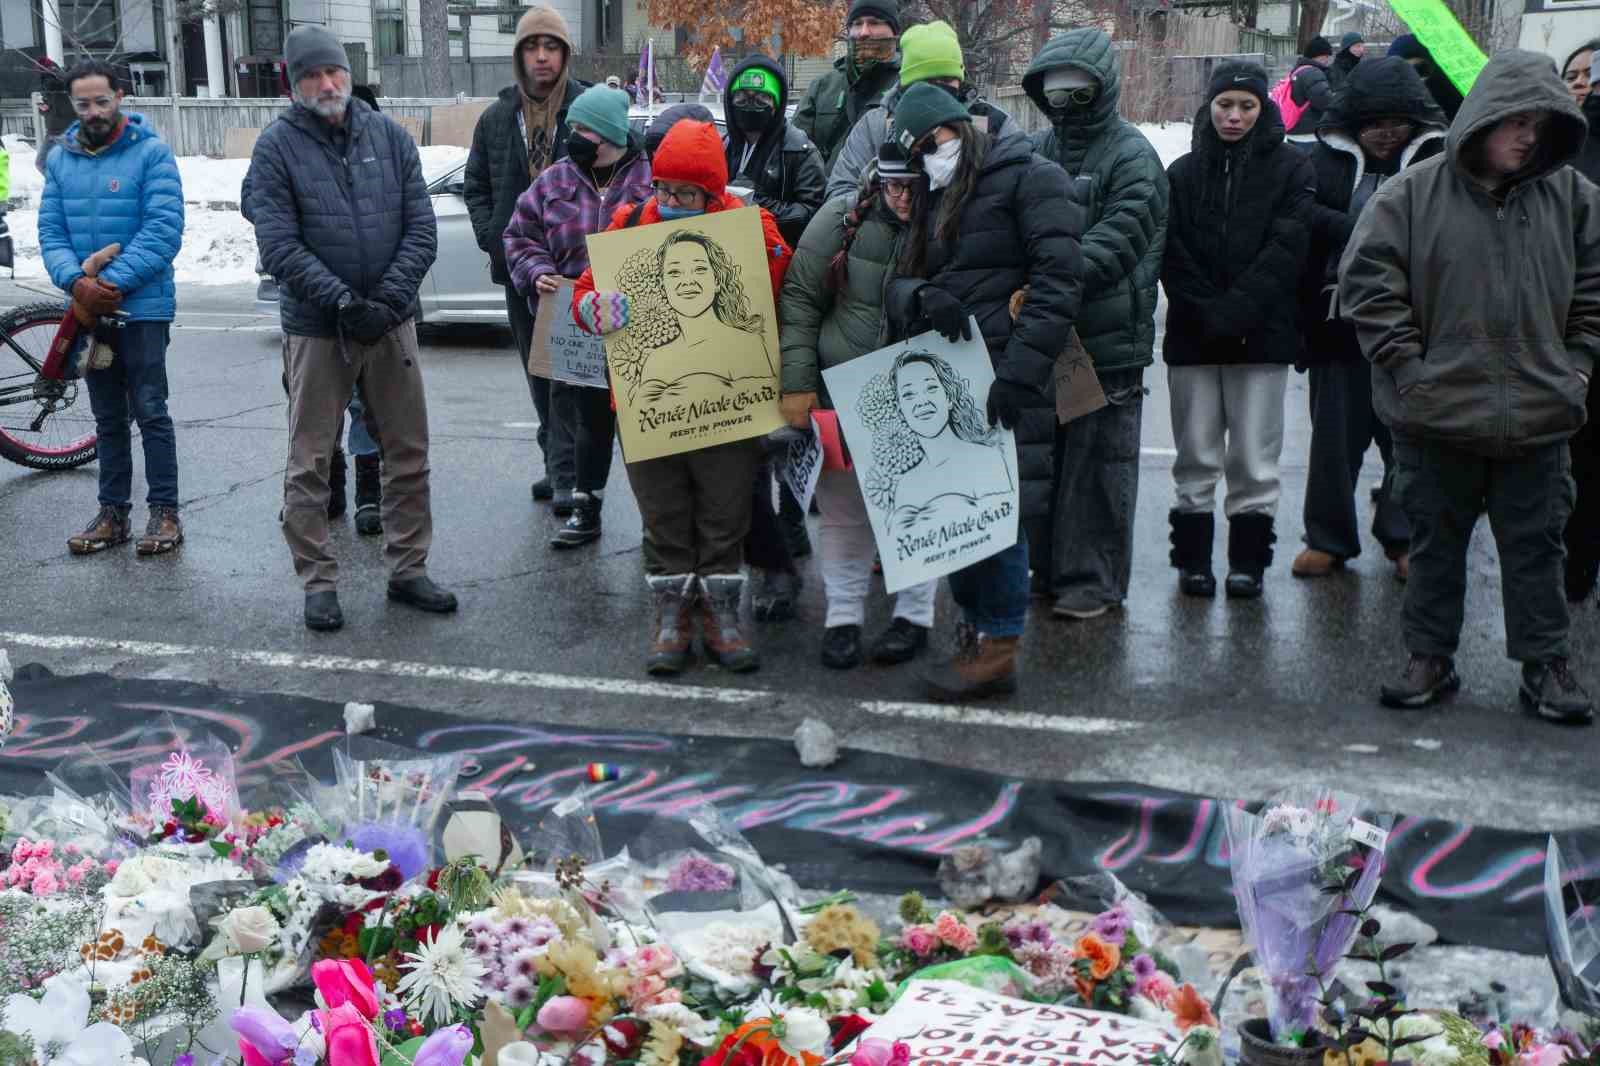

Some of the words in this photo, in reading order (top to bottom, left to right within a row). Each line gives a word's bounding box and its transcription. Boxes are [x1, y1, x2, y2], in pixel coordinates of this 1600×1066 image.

[639, 404, 686, 433] Renée
[687, 393, 732, 424] Nicole
[669, 426, 696, 440] REST
[699, 423, 710, 433] IN
[713, 413, 753, 430] POWER
